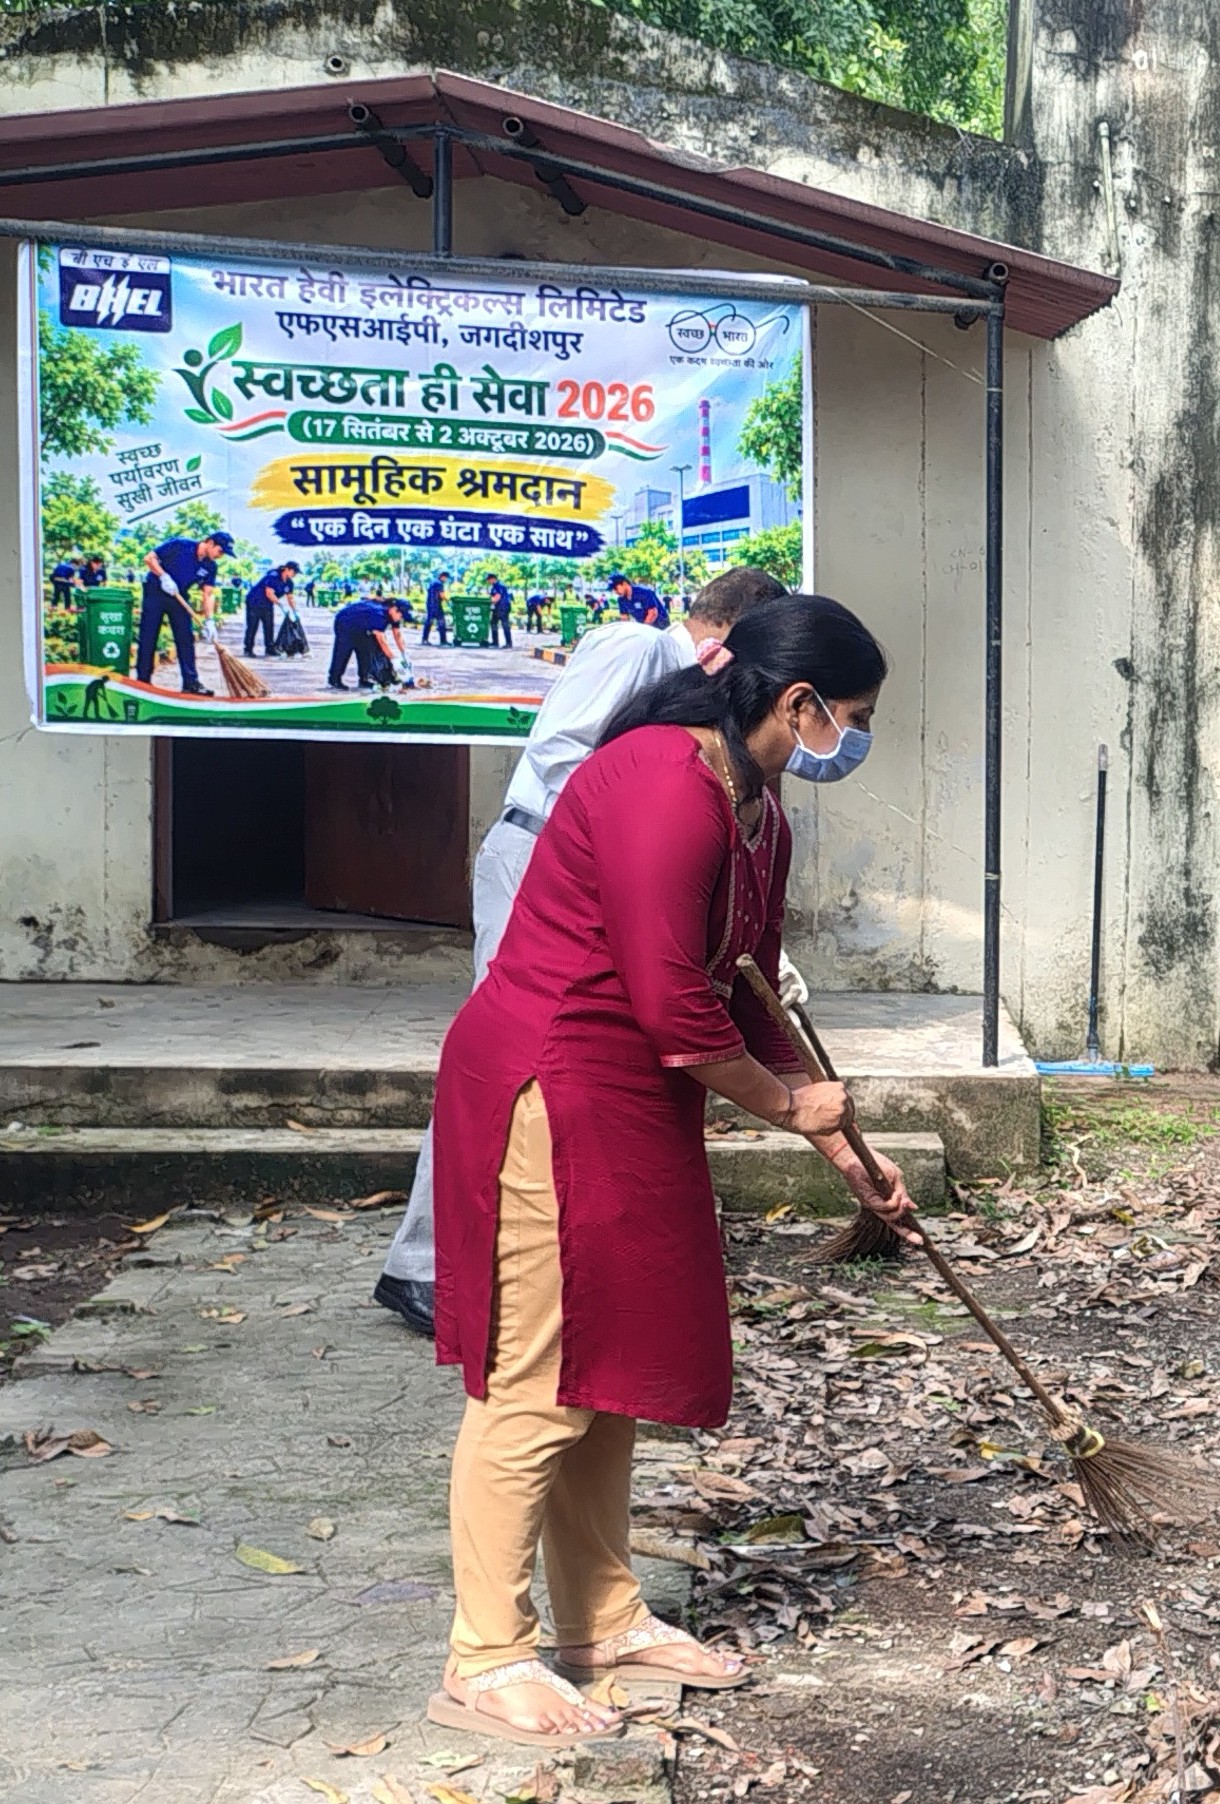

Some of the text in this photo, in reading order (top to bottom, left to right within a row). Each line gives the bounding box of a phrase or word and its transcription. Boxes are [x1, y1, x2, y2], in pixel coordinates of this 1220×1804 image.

[69, 273, 162, 325] BHEL
[211, 267, 648, 324] भारत हेवी इलेक्ट्रिकल्स लिमिटेड
[275, 311, 584, 361] एफएसआईपी, जगदीशपुर
[676, 327, 704, 339] स्वच्छ
[722, 331, 748, 342] भारत
[231, 360, 655, 422] स्वच्छता ही सेवा 2026
[115, 443, 162, 465] स्वच्छ
[302, 416, 595, 455] (17 सितंबर से 2 अक्टूबर 2026)
[108, 459, 180, 486] पर्यावरण
[290, 455, 587, 510] सामूहिक श्रमदान
[114, 474, 202, 512] सुखी जीवन
[351, 511, 391, 540] दिन
[395, 518, 435, 542] एक
[439, 515, 482, 542] घंटा
[487, 523, 525, 547] एक
